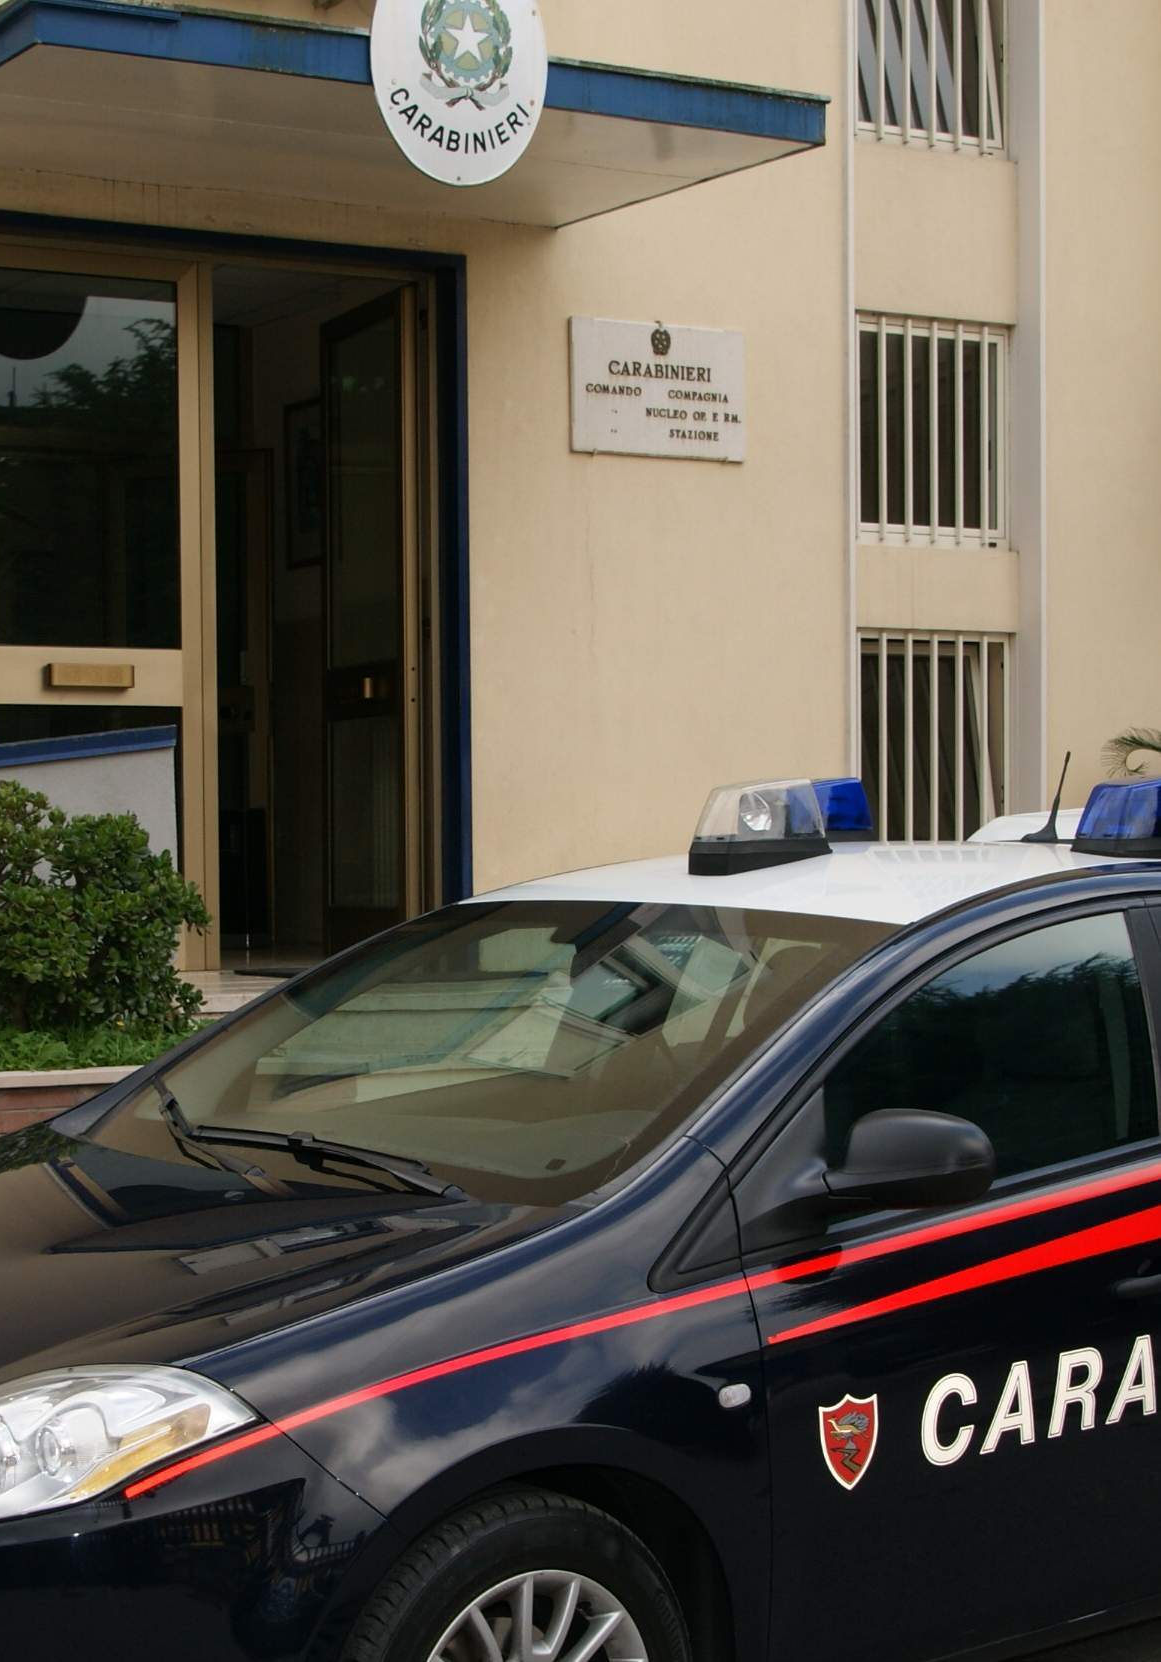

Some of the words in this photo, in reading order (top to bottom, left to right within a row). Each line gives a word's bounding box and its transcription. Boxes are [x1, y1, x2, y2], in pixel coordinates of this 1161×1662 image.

[390, 88, 529, 154] CARABINIERI
[608, 360, 711, 383] CARABINIERI
[585, 383, 642, 397] COMANDO
[668, 390, 729, 404] COMPAGNIA
[645, 407, 687, 420] NUCLEO
[712, 412, 719, 422] E
[669, 429, 719, 442] STAZIONE
[921, 1334, 1157, 1466] CARA
